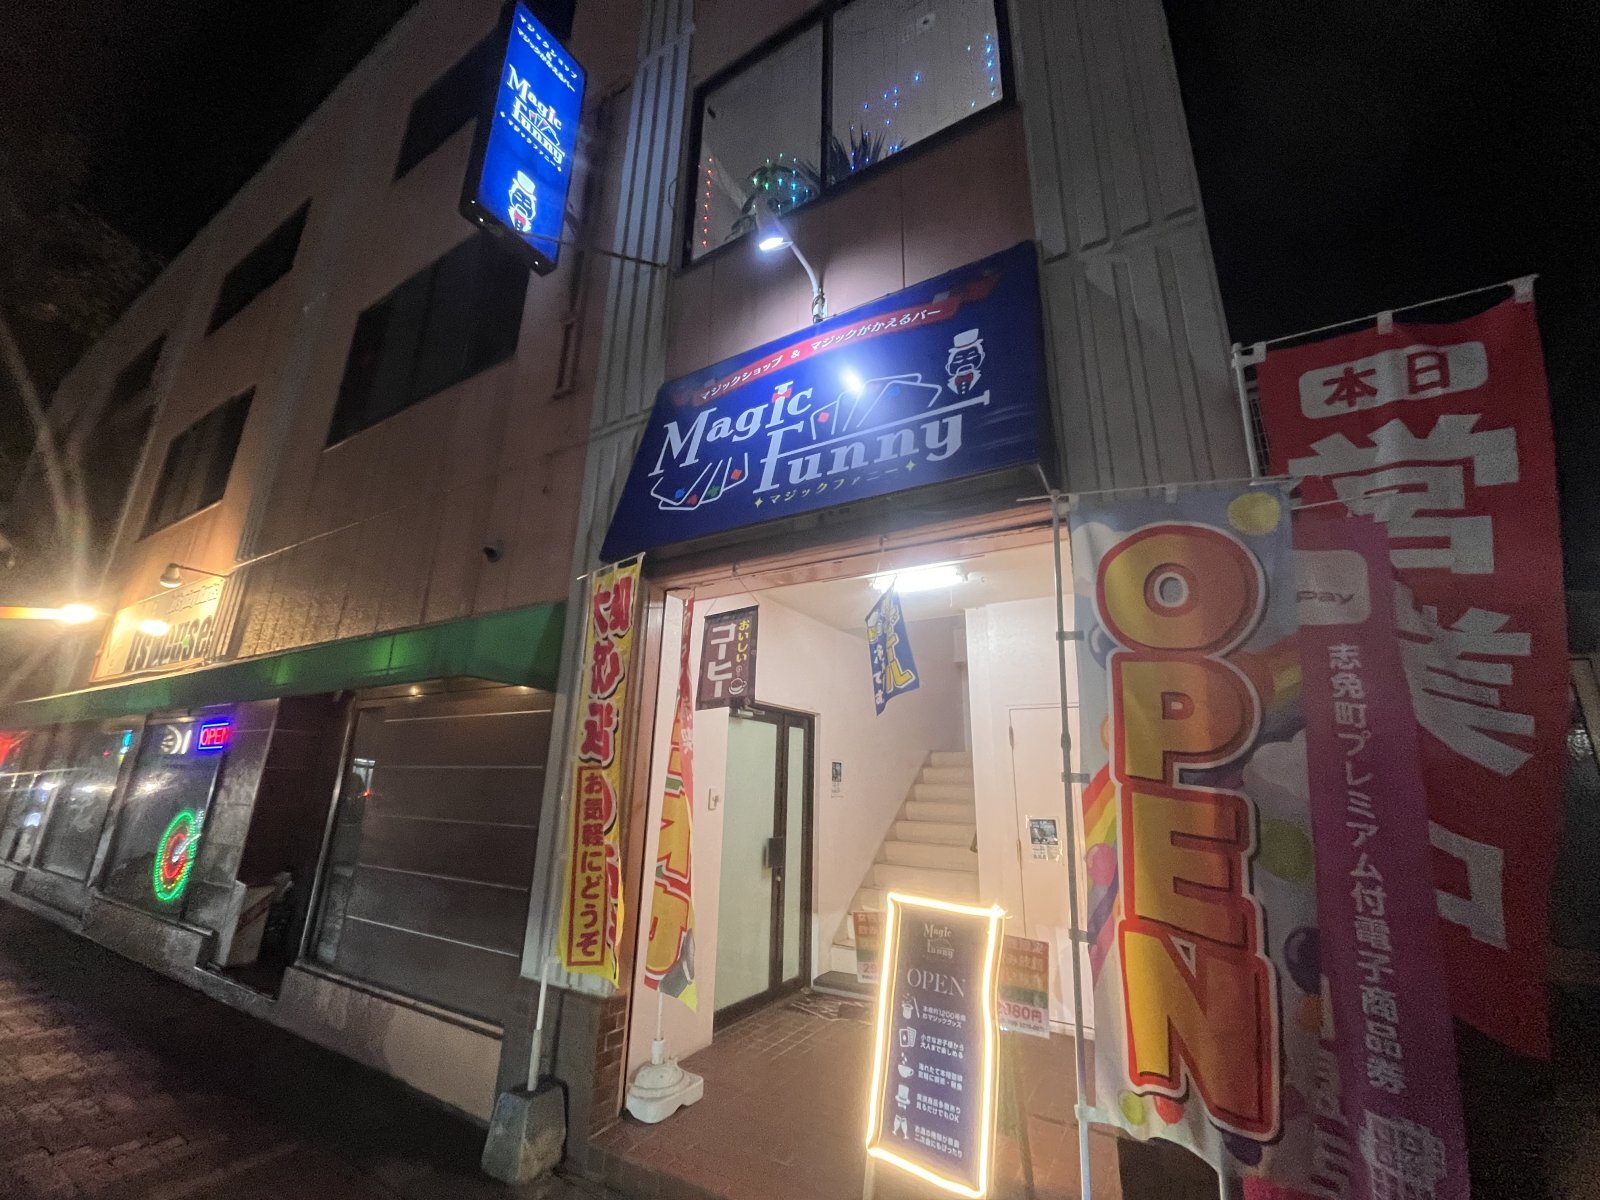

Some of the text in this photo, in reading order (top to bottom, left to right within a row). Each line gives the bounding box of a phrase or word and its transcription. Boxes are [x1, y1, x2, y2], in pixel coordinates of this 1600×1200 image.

[507, 63, 563, 131] Magic
[512, 96, 566, 165] Funny
[700, 307, 941, 400] マジックショップ & マジックがかえるバー
[1323, 351, 1452, 408] 本日
[648, 380, 814, 477] Magic
[753, 391, 990, 495] Funny
[769, 467, 901, 505] マジックファニー
[707, 622, 737, 698] コーヒー
[736, 618, 750, 663] おいしい
[1096, 521, 1281, 1141] OPEN
[1328, 643, 1407, 1094] 志免町プレミアム付電子商品券
[923, 922, 952, 938] Magic
[906, 967, 965, 998] OPEN
